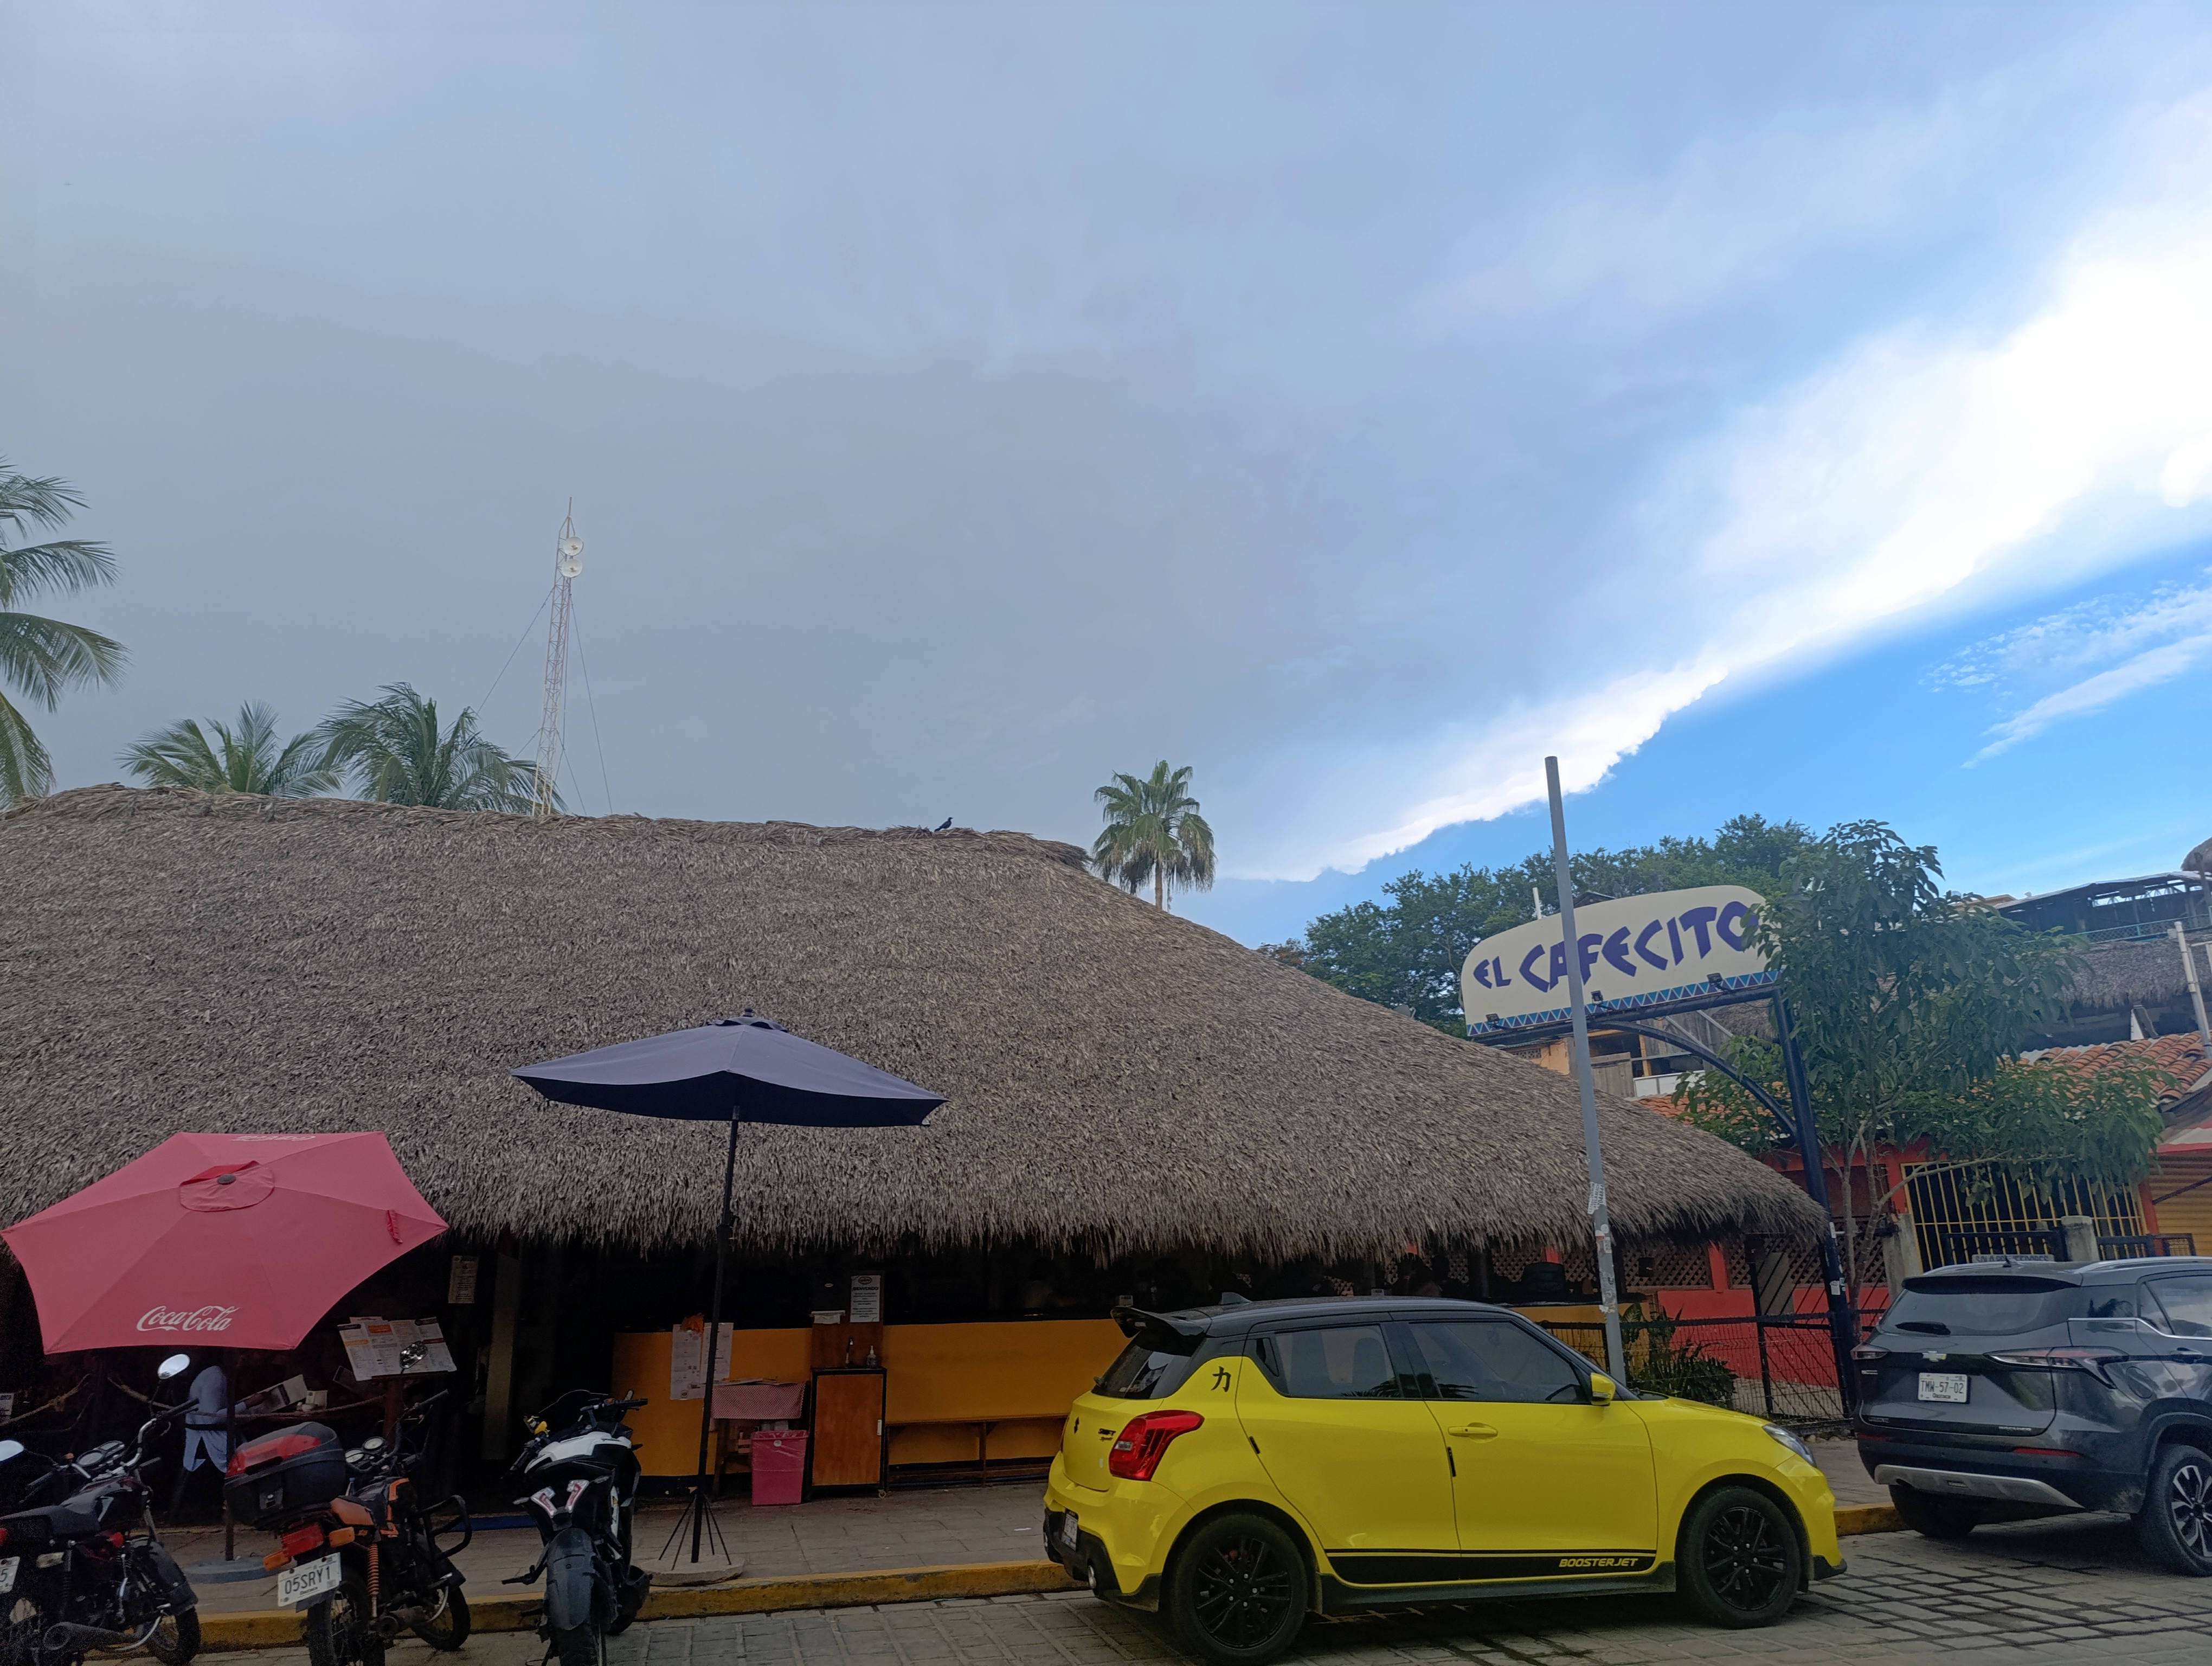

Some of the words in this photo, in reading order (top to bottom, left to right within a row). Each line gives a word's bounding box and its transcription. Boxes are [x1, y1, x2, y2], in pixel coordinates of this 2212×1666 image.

[1474, 956, 1512, 989] EL
[1519, 901, 1759, 993] CAFECITO
[137, 1305, 240, 1331] Coca-Cola
[1558, 1558, 1638, 1567] BOOSTERJET
[285, 1566, 330, 1594] 05SRY1
